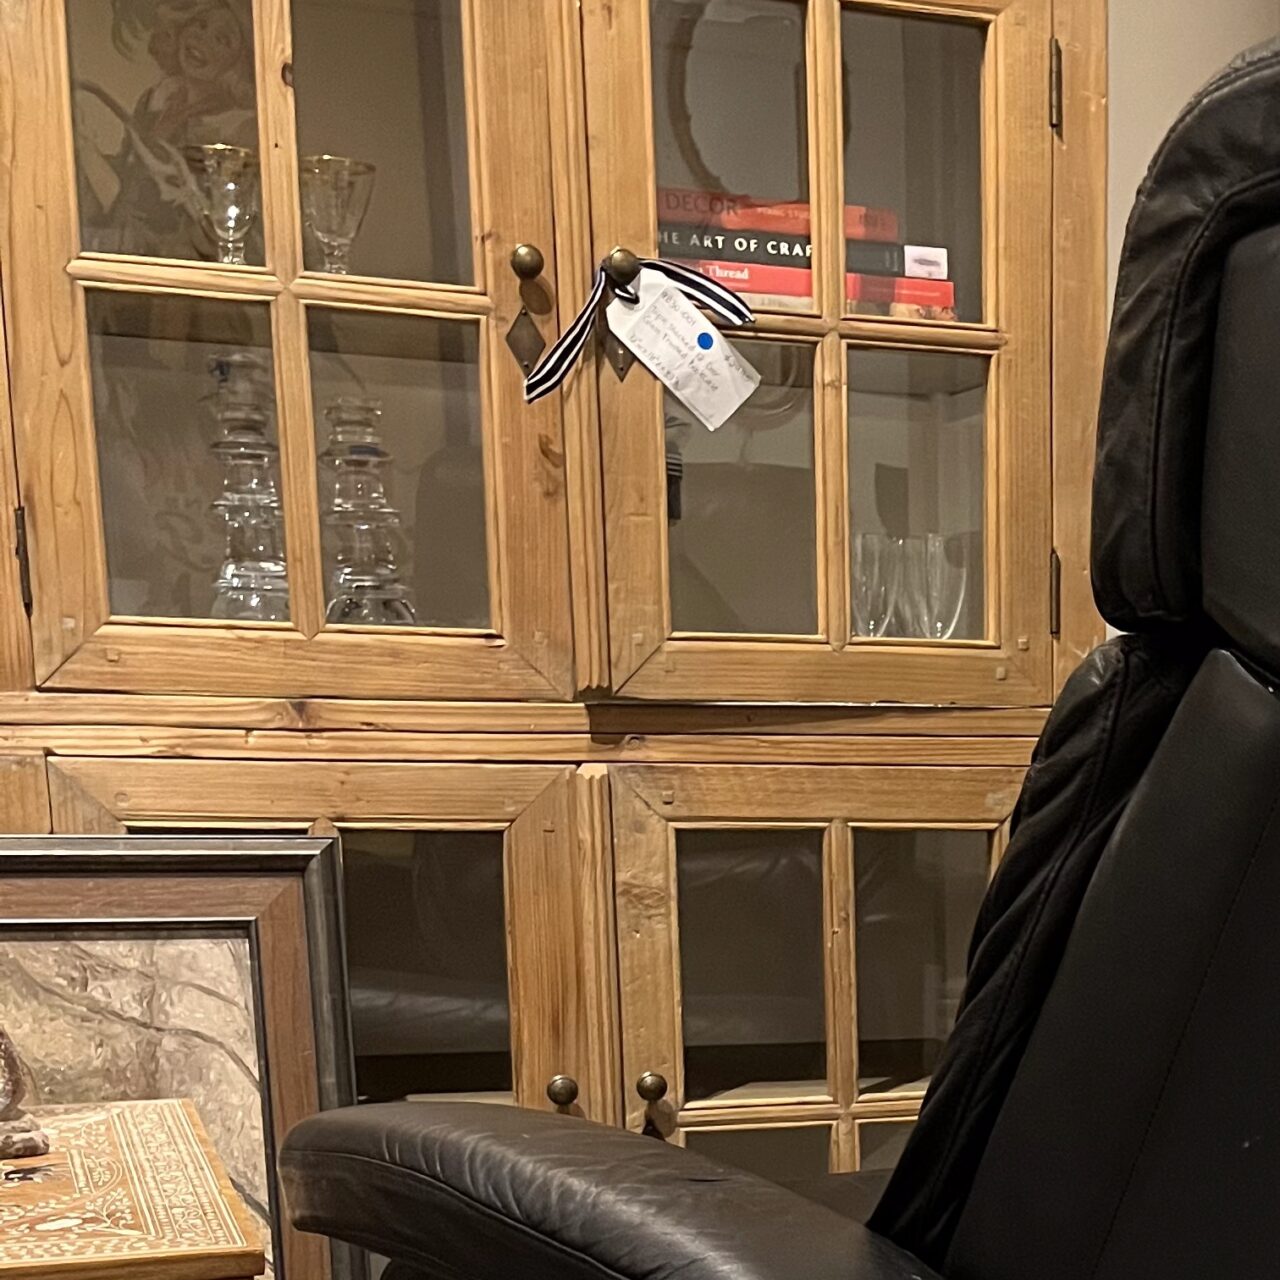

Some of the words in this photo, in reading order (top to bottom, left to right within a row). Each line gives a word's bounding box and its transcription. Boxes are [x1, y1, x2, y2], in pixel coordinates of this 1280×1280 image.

[659, 231, 680, 245] HE
[690, 234, 726, 250] ART
[734, 237, 758, 253] OF
[767, 240, 812, 257] CRAF
[708, 265, 749, 280] Thread
